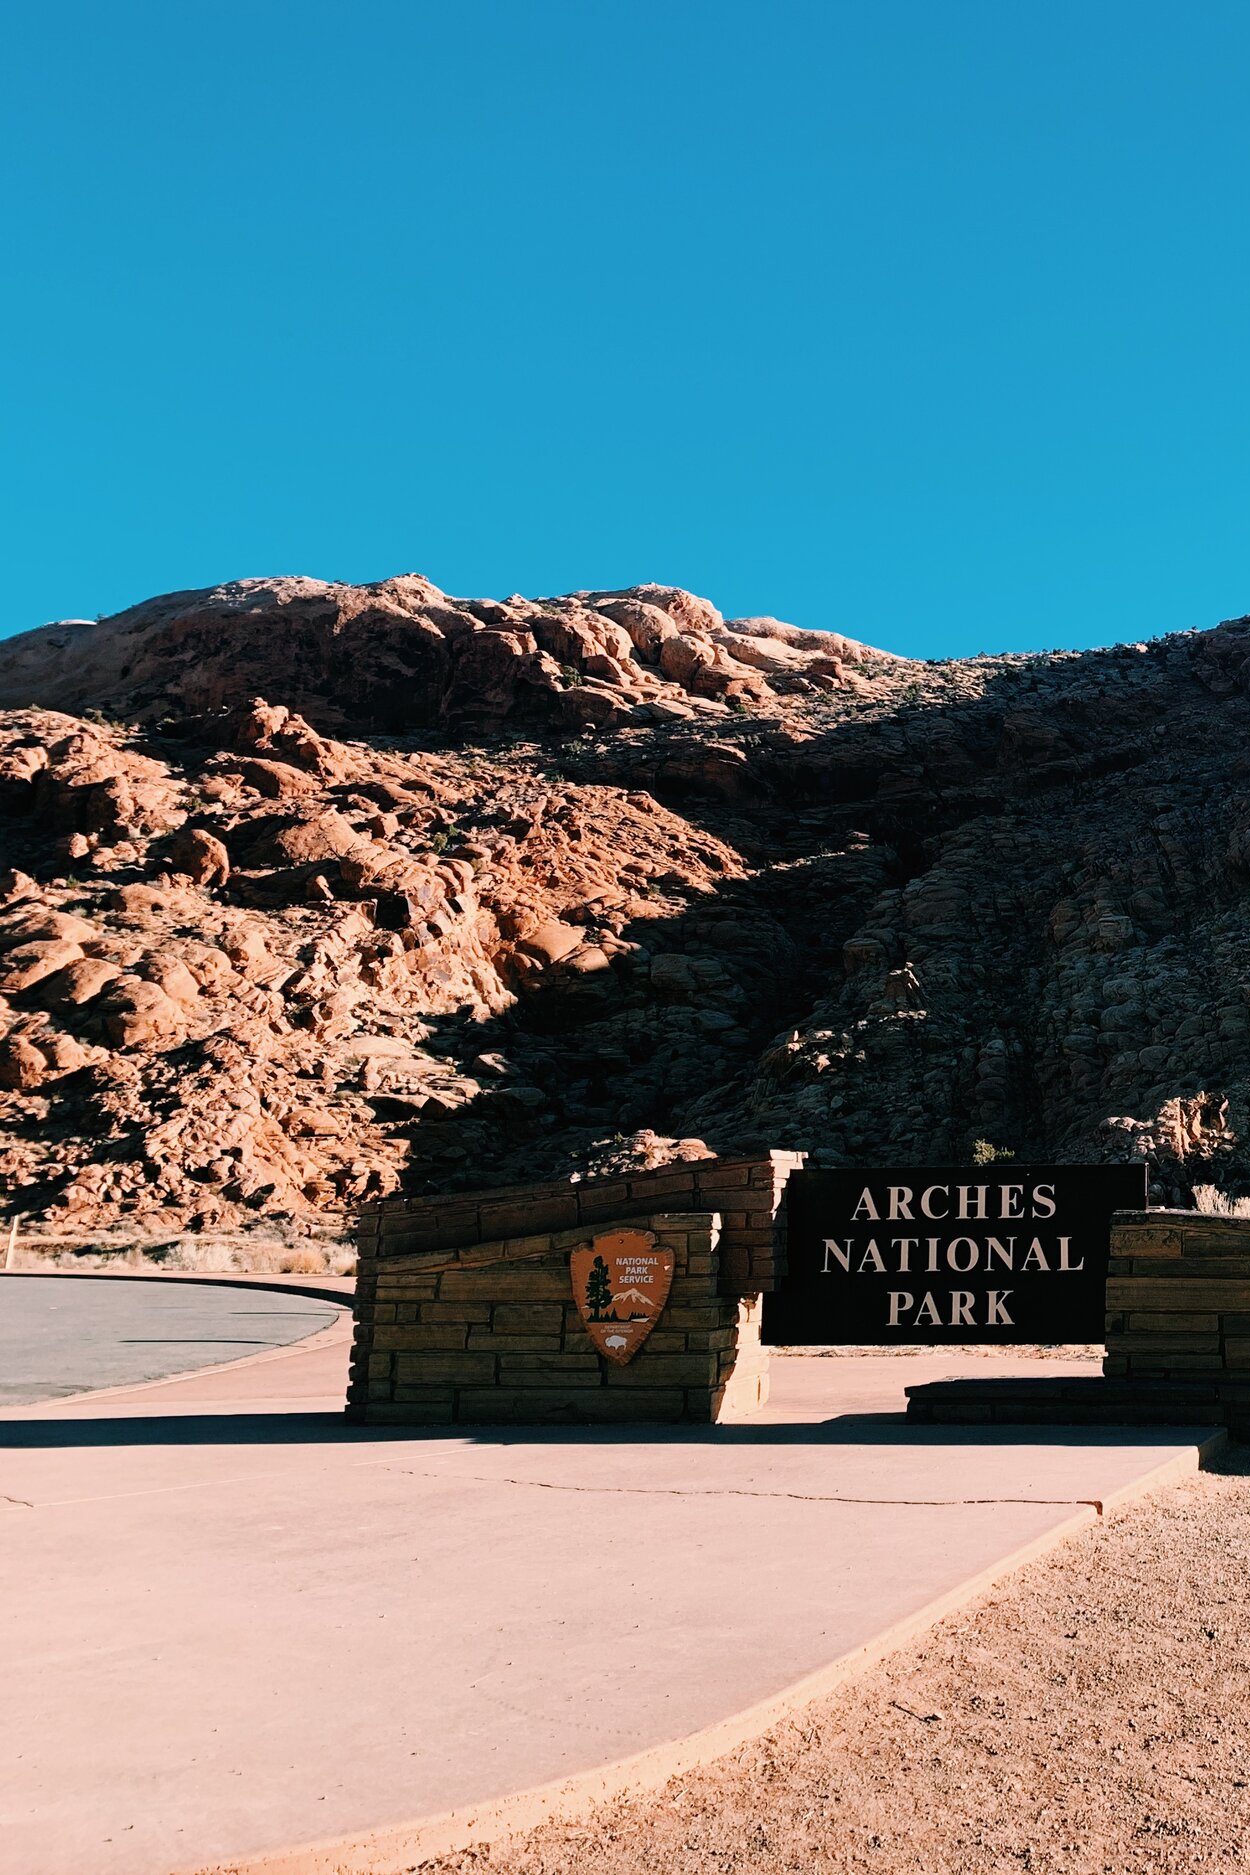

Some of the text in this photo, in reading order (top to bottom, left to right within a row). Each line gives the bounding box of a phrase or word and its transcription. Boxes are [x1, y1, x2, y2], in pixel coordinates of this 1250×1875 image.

[850, 1184, 1057, 1221] ARCHES
[615, 1257, 659, 1265] NATIONAL
[820, 1236, 1085, 1273] NATIONAL
[618, 1275, 654, 1284] SERVICE
[625, 1266, 648, 1275] PARK
[885, 1290, 1016, 1326] PARK
